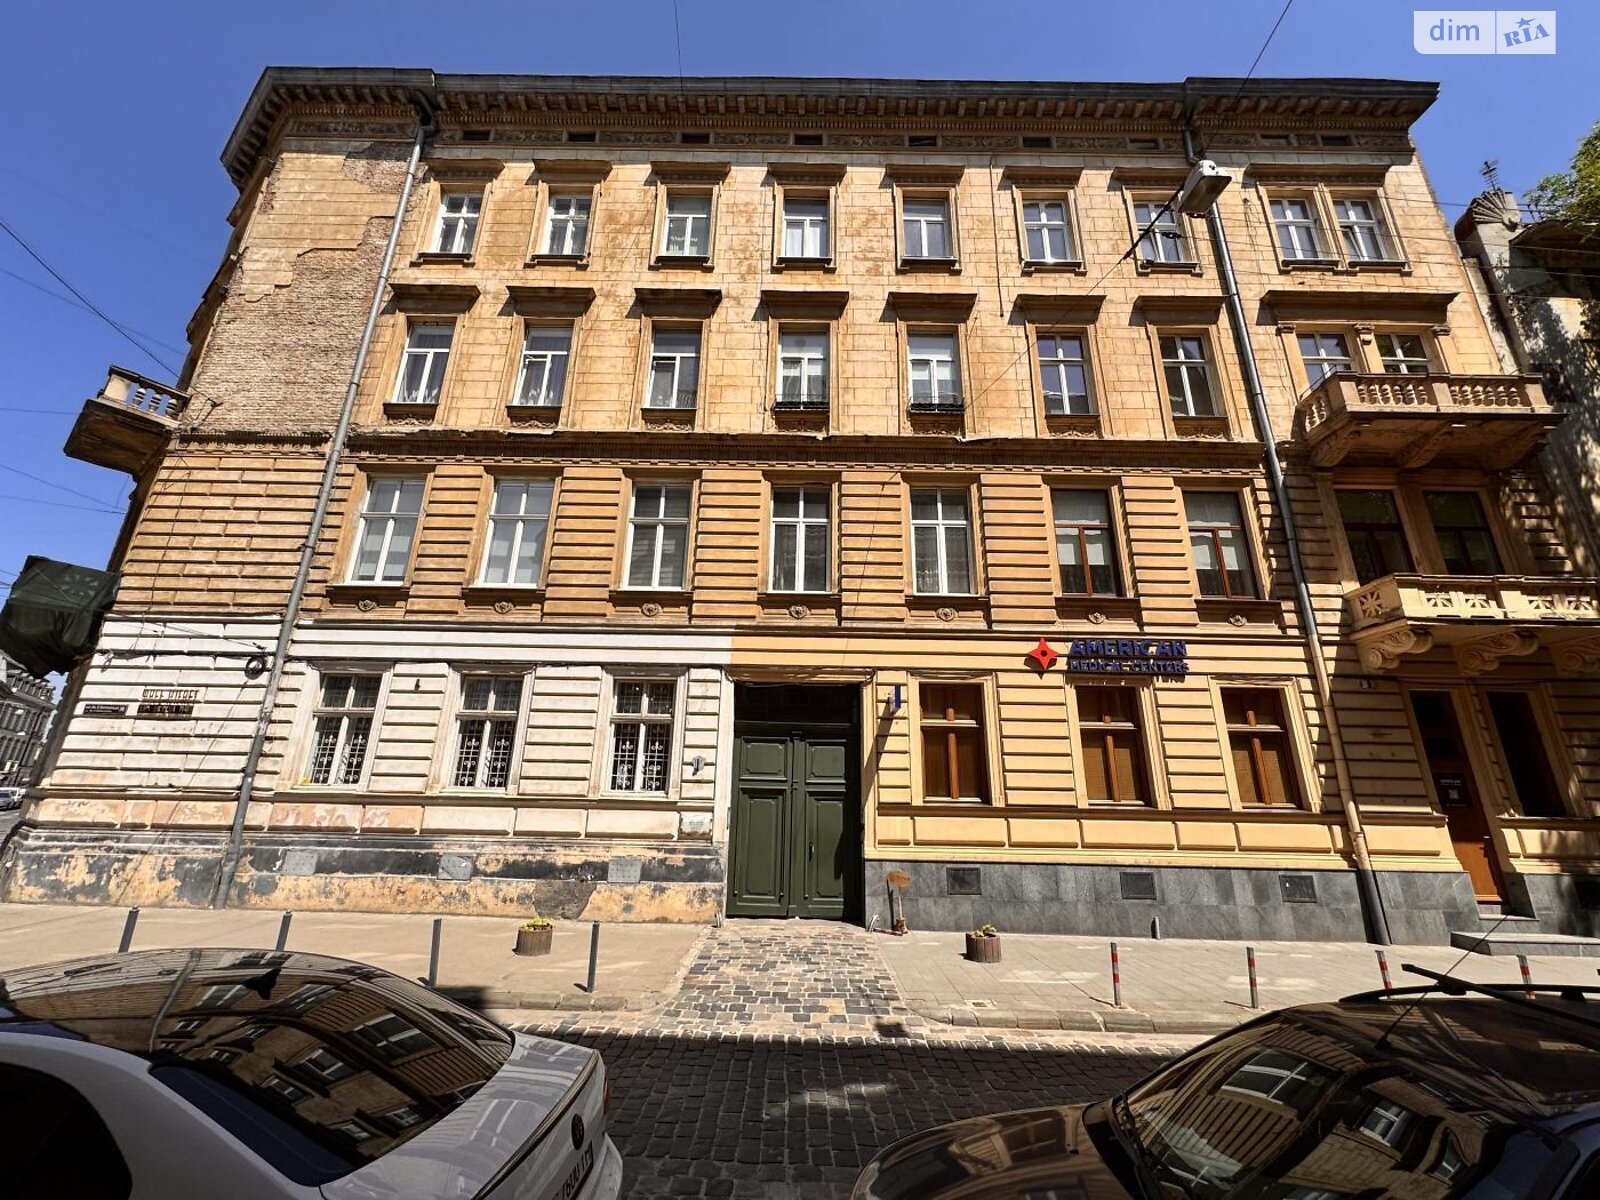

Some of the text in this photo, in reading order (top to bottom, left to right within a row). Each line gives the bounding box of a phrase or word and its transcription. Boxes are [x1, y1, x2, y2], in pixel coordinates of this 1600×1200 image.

[1070, 640, 1187, 656] AMERICAN
[1070, 660, 1189, 674] MEDICAL CENTERS
